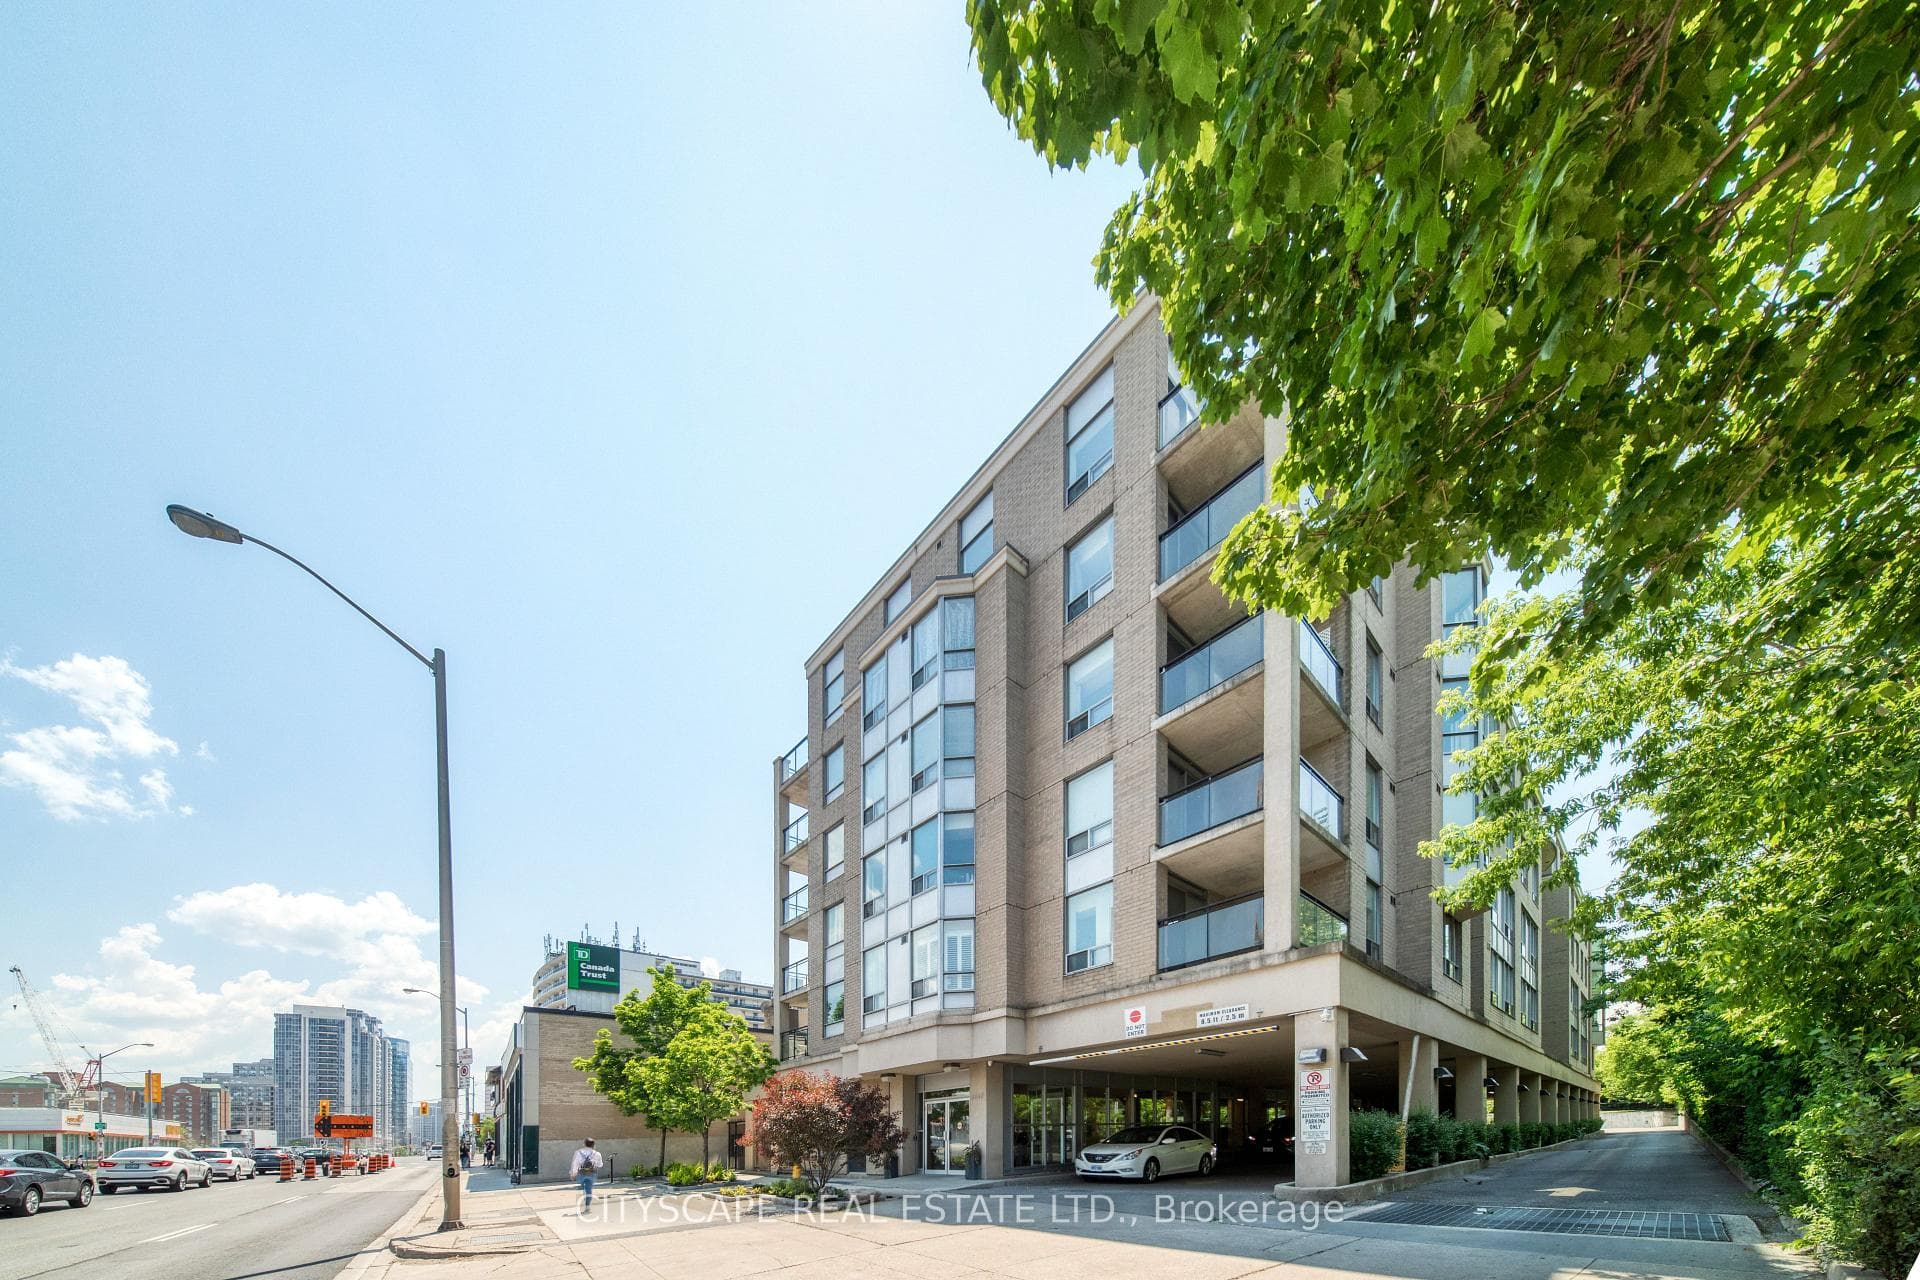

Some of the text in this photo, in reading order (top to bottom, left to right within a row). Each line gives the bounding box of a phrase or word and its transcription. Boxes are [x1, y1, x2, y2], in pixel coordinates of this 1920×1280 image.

[575, 949, 589, 959] TD
[580, 962, 615, 972] Canada
[580, 970, 607, 979] Trust
